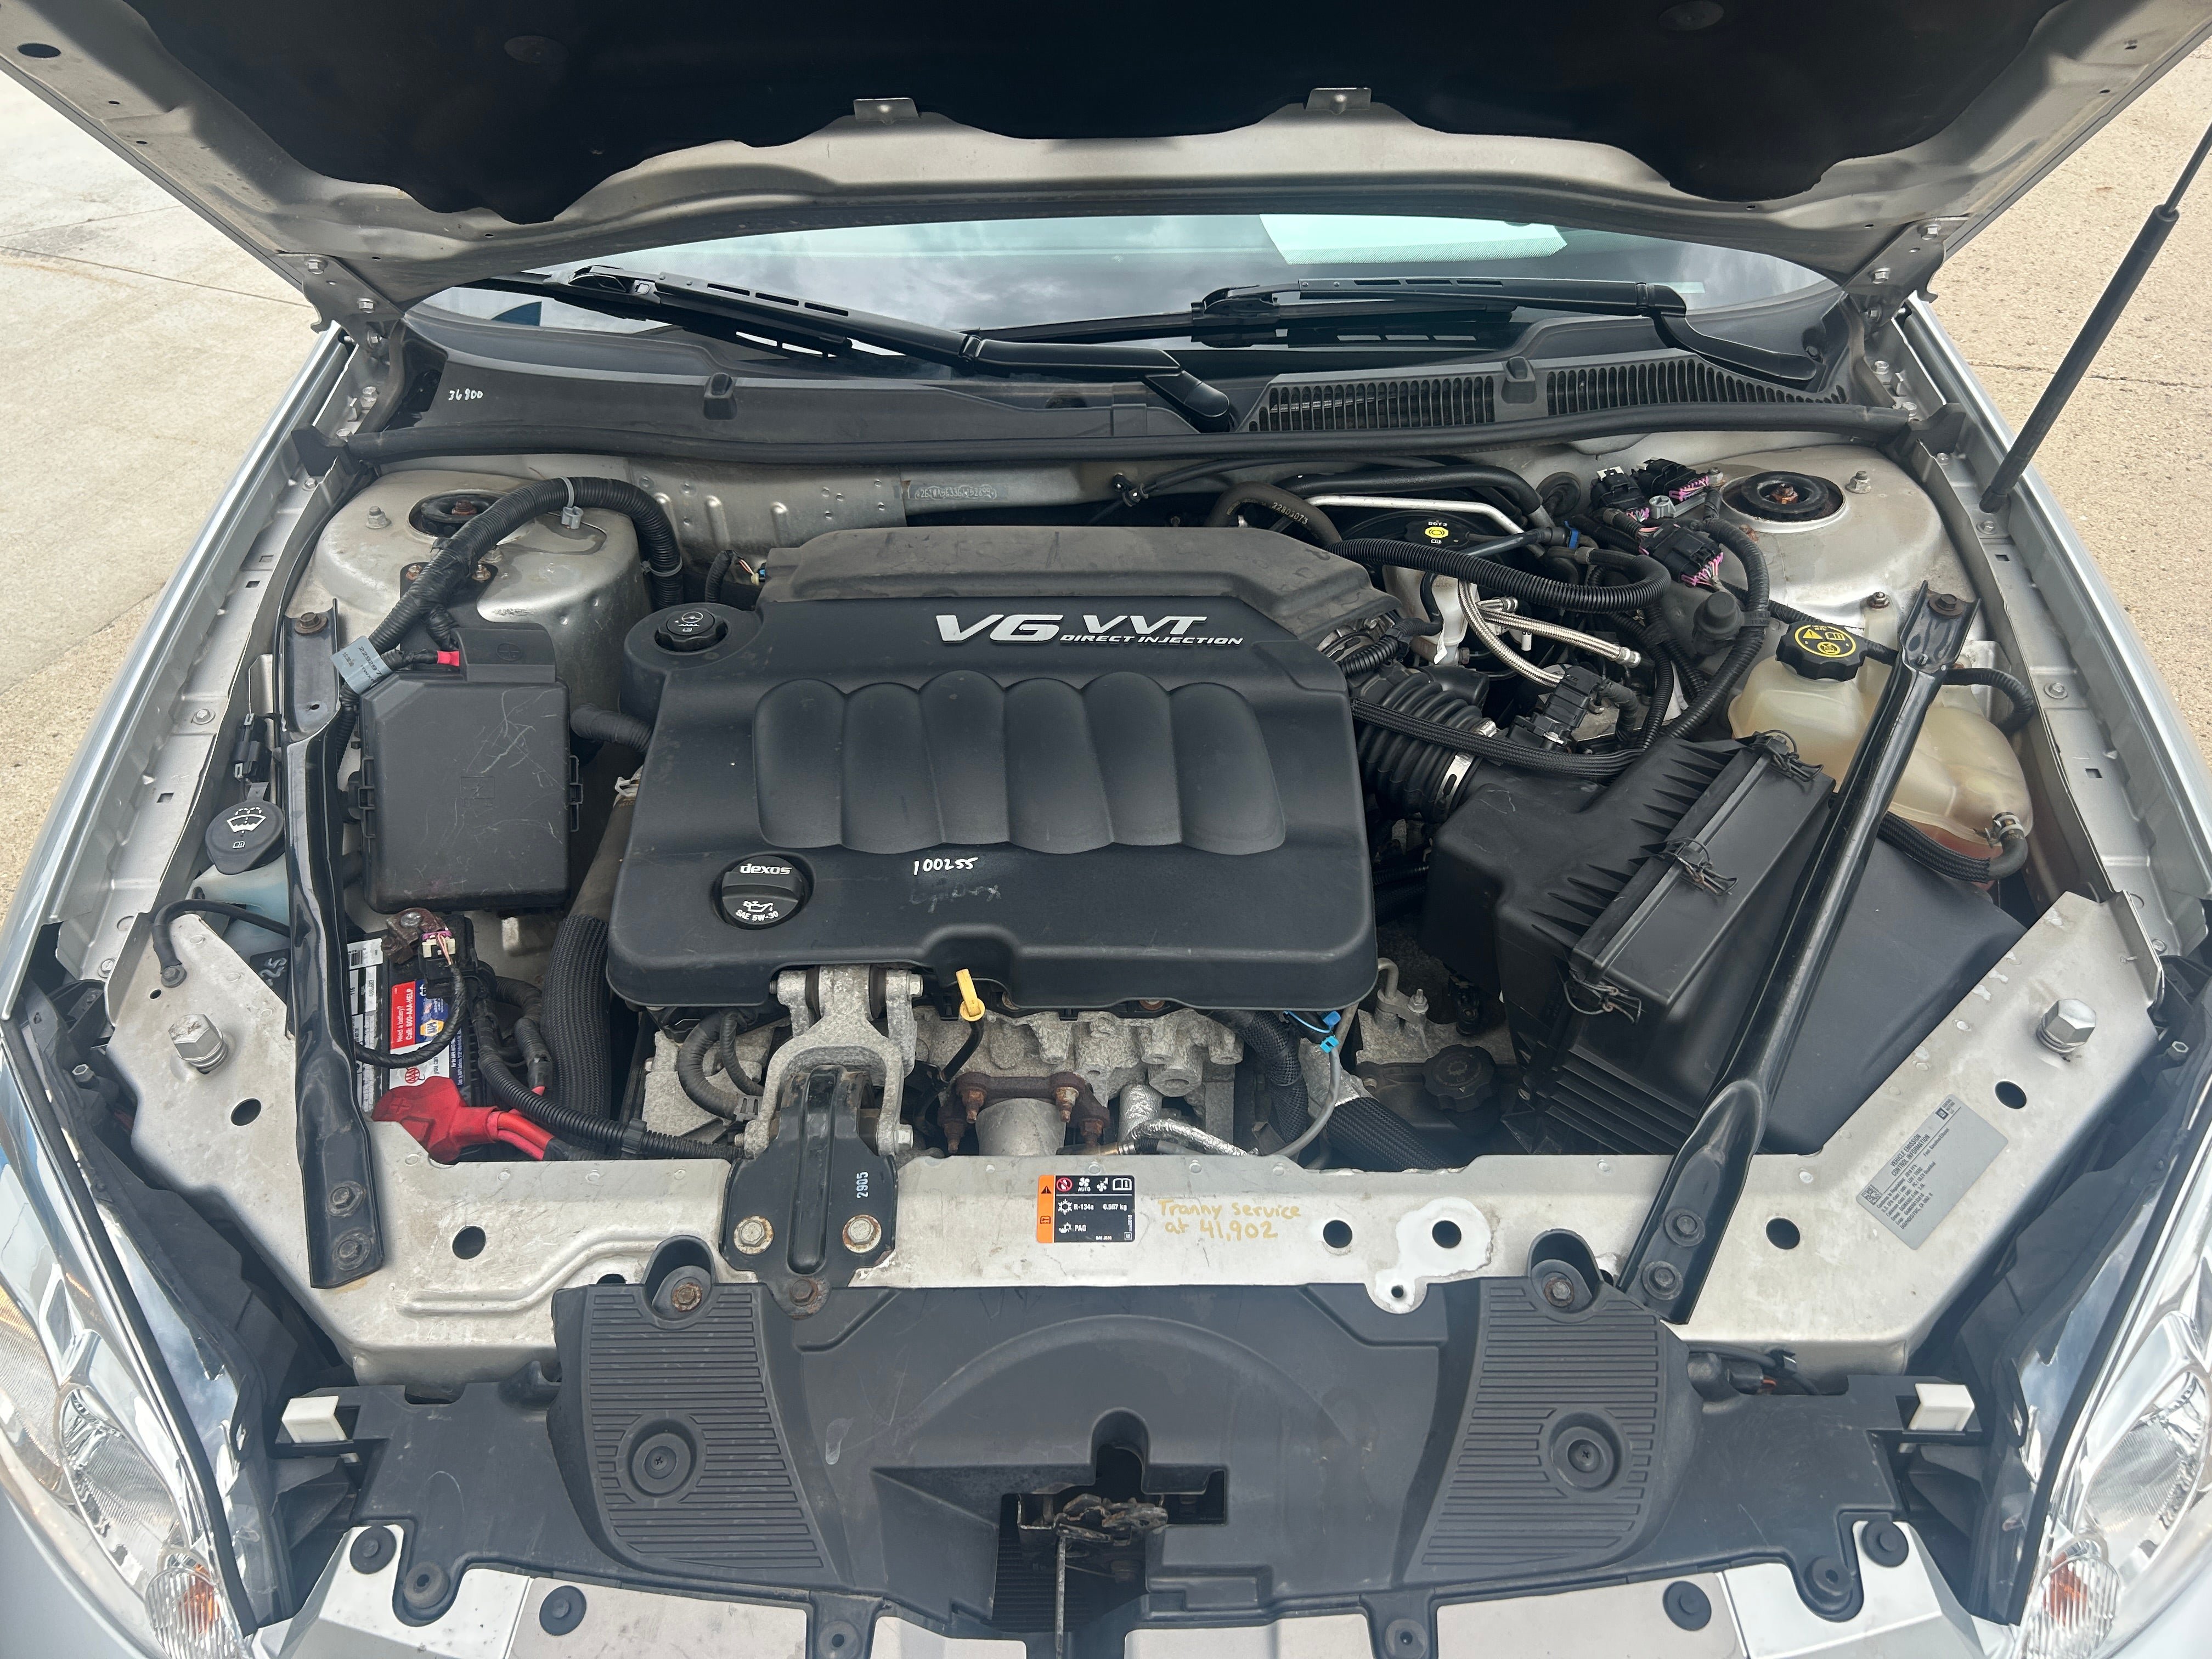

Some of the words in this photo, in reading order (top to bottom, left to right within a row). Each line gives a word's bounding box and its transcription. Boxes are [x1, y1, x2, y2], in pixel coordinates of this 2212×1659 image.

[936, 614, 1064, 641] V6
[1082, 616, 1208, 635] VVT
[1060, 634, 1136, 643] DIRECT
[1137, 635, 1244, 645] INJECTION
[740, 864, 792, 874] dexos
[913, 857, 979, 875] 100255
[736, 909, 751, 920] SAE
[752, 911, 779, 921] 5W-30
[397, 1006, 405, 1025] battery?
[427, 1022, 437, 1034] NAPA
[1889, 1150, 1906, 1167] VEHICLE
[1903, 1133, 1921, 1152] EMISSION
[1891, 1158, 1909, 1176] CONTROL
[1905, 1133, 1930, 1160] INFORMATION
[856, 1171, 868, 1199] 2905
[1119, 1203, 1127, 1211] kg
[1158, 1198, 1223, 1221] Tranny
[1165, 1217, 1189, 1234] at
[1200, 1219, 1278, 1242] 41,902
